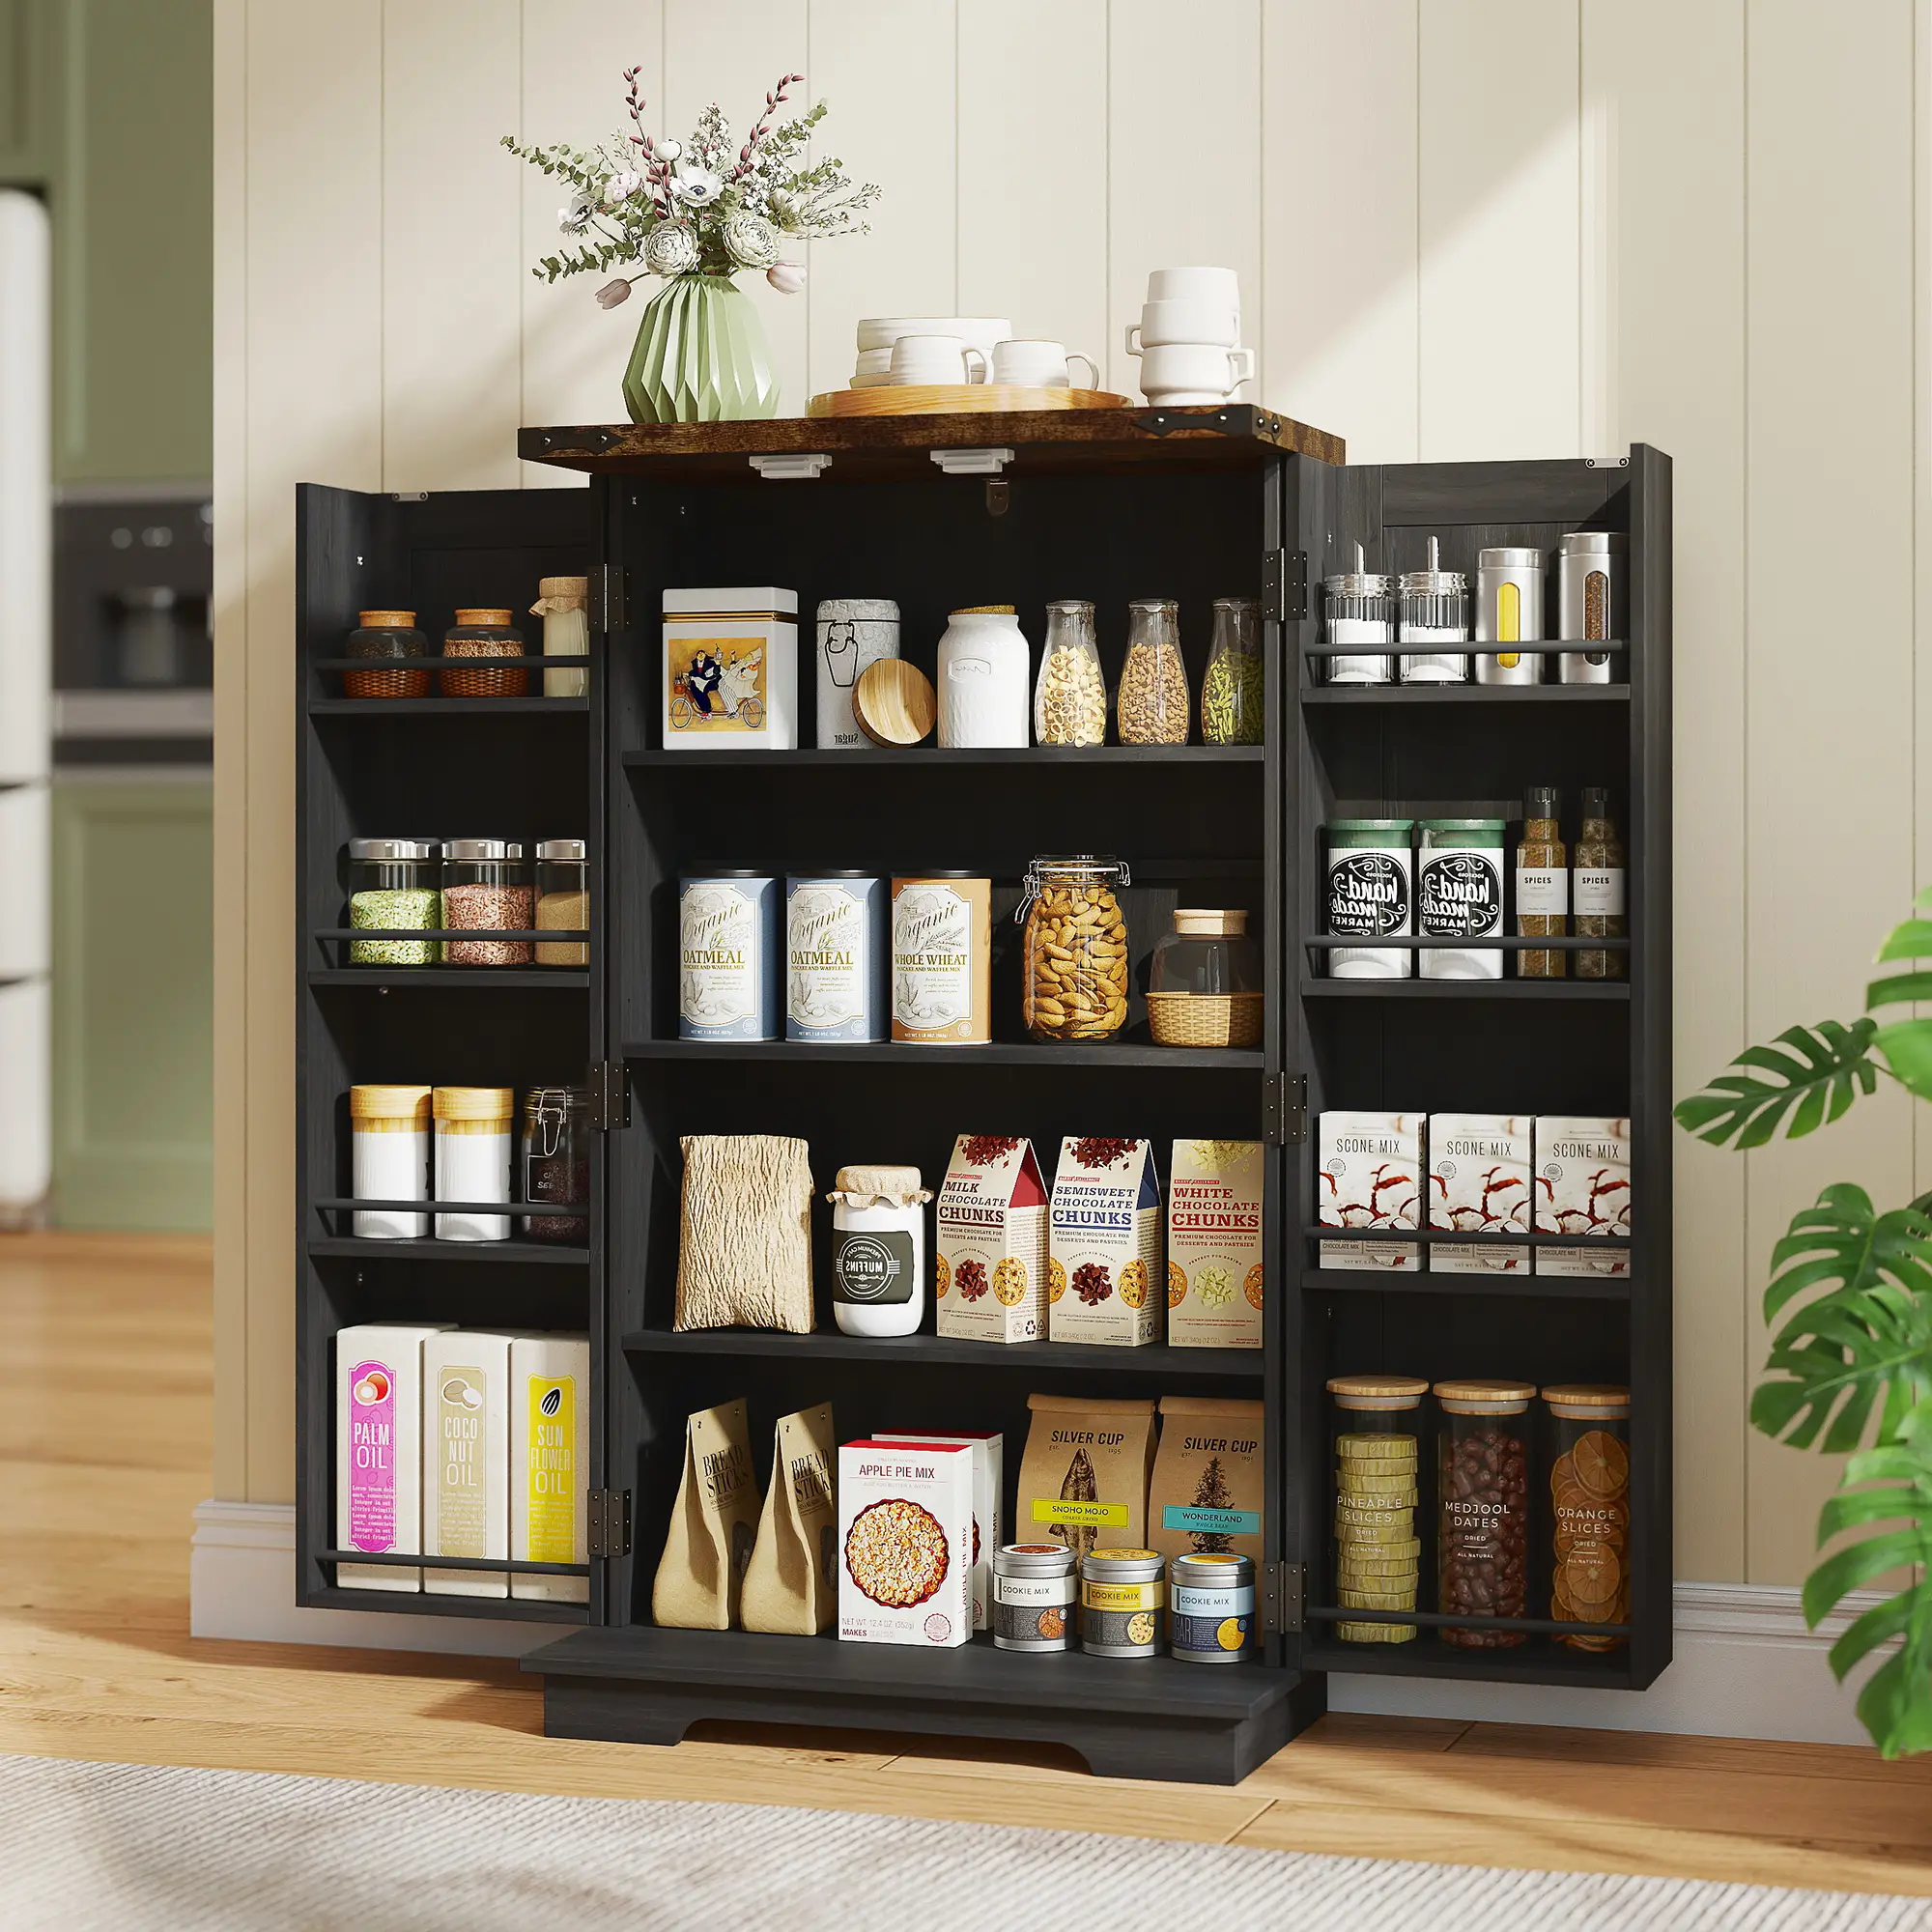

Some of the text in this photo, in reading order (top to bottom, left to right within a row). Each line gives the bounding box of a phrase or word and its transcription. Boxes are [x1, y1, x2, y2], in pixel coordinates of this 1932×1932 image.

[682, 900, 742, 949] Organic
[789, 900, 850, 949] Organic
[895, 901, 958, 949] Organic
[683, 950, 746, 964] OATMEAL
[790, 951, 854, 965] OATMEAL
[895, 954, 968, 966] WHOLE WHEAT
[1337, 1138, 1400, 1153] SCONE MIX
[1447, 1140, 1511, 1156] SCONE MIX
[1553, 1143, 1619, 1159] SCONE MIX
[944, 1181, 980, 1193] MILK
[1056, 1186, 1135, 1197] SEMISWEET
[1174, 1188, 1233, 1198] WHITE
[941, 1194, 1007, 1207] CHOCOLATE
[1054, 1198, 1133, 1208] CHOCOLATE
[1173, 1202, 1260, 1210] CHOCOLATE
[939, 1207, 1005, 1223] CHUNKS
[1053, 1209, 1132, 1225] CHUNKS
[1172, 1213, 1259, 1227] CHUNKS
[354, 1422, 389, 1445] PALM
[444, 1416, 478, 1439] COCO
[537, 1424, 563, 1447] SUN
[1051, 1430, 1124, 1445] SILVER CUP
[448, 1440, 474, 1463] NUT
[1184, 1436, 1258, 1453] SILVER CUP
[356, 1445, 387, 1469] OIL
[531, 1448, 571, 1471] FLOWER
[702, 1445, 744, 1478] BREAD
[790, 1449, 829, 1482] BREAD
[859, 1464, 935, 1479] APPLE PIE MIX
[446, 1463, 477, 1487] OIL
[535, 1471, 566, 1494] OIL
[706, 1469, 750, 1498] STICKS
[1337, 1495, 1403, 1508] PINEAPLE
[1445, 1501, 1511, 1515] MEDJOOL
[1182, 1513, 1242, 1522] WONDERLAND
[1345, 1511, 1392, 1522] SLICES
[1557, 1507, 1615, 1520] ORANGE
[1454, 1517, 1499, 1528] DATES
[1561, 1521, 1611, 1534] SLICES
[1003, 1585, 1032, 1595] COOKIE
[1092, 1591, 1121, 1600] COOKIE
[1180, 1596, 1211, 1605] COOKIE
